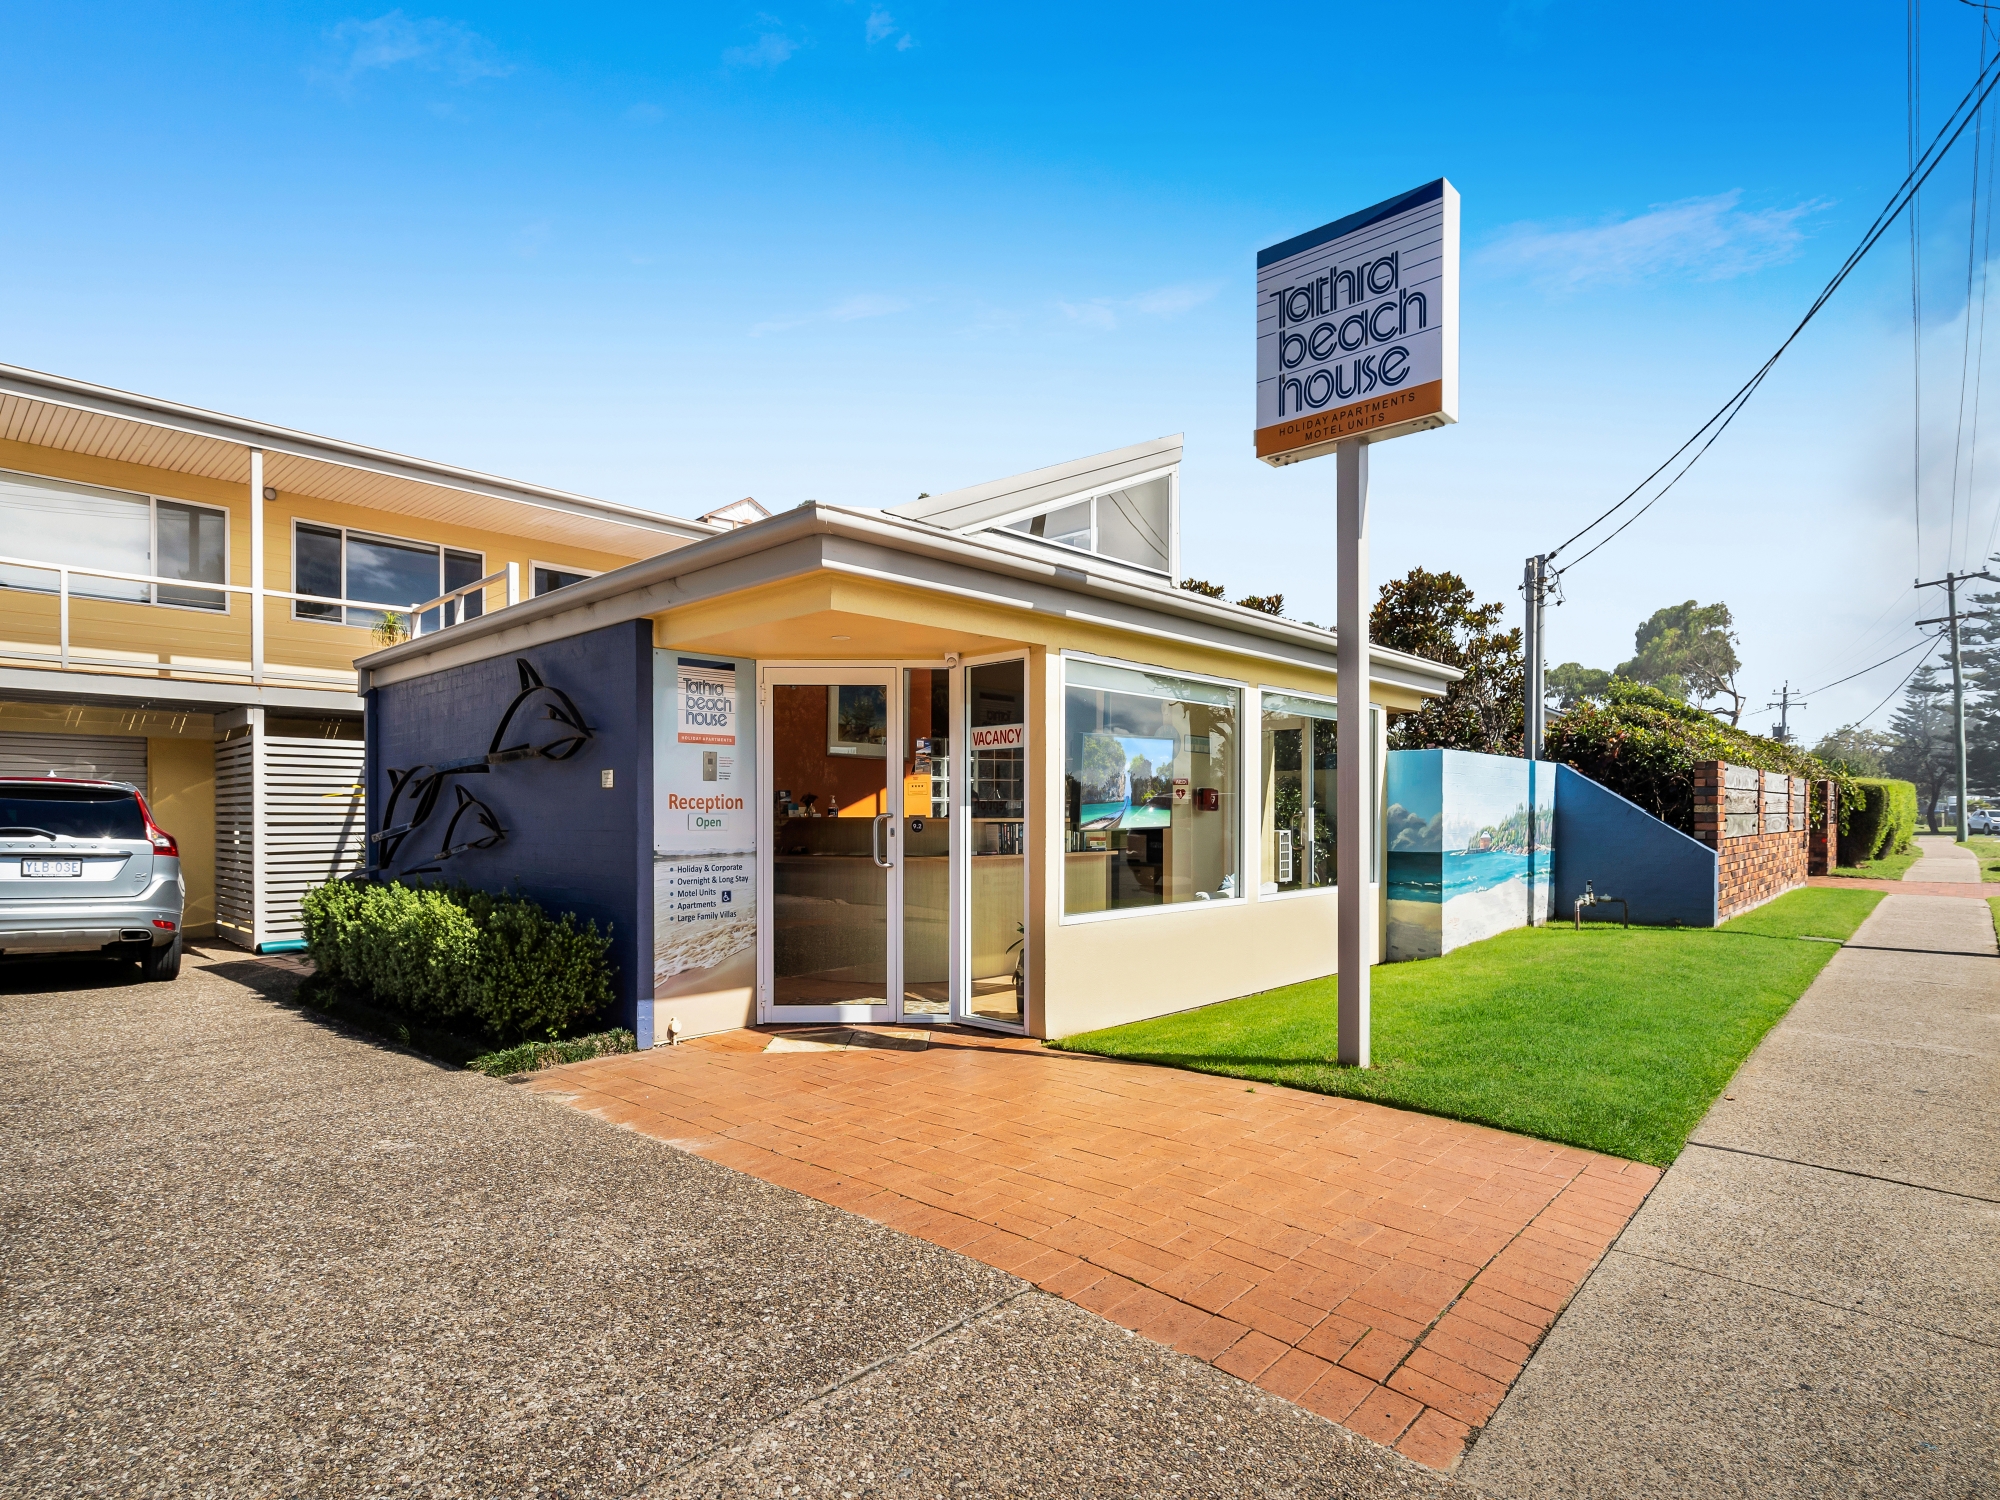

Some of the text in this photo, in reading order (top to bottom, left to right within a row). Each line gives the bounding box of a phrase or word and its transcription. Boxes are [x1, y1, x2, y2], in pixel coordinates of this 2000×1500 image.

[1269, 251, 1399, 329] Tathra
[1279, 288, 1427, 371] beach
[1279, 345, 1410, 417] house
[1279, 392, 1416, 437] HOLIDAY APARTMENTS
[1305, 412, 1386, 441] MOTEL UNITS
[683, 678, 724, 696] Tathra
[685, 694, 731, 712] beach
[685, 709, 728, 727] house
[972, 728, 1022, 746] VACANCY
[668, 793, 744, 813] Reception
[696, 816, 722, 829] Open
[677, 865, 702, 873] Holiday
[711, 864, 743, 873] Corporate
[677, 877, 710, 886] Overnight
[718, 876, 734, 884] Long
[735, 875, 748, 883] Stay
[677, 888, 716, 897] Motel Units
[677, 901, 716, 910] Apartments
[677, 914, 696, 922] Large
[697, 912, 718, 920] Family
